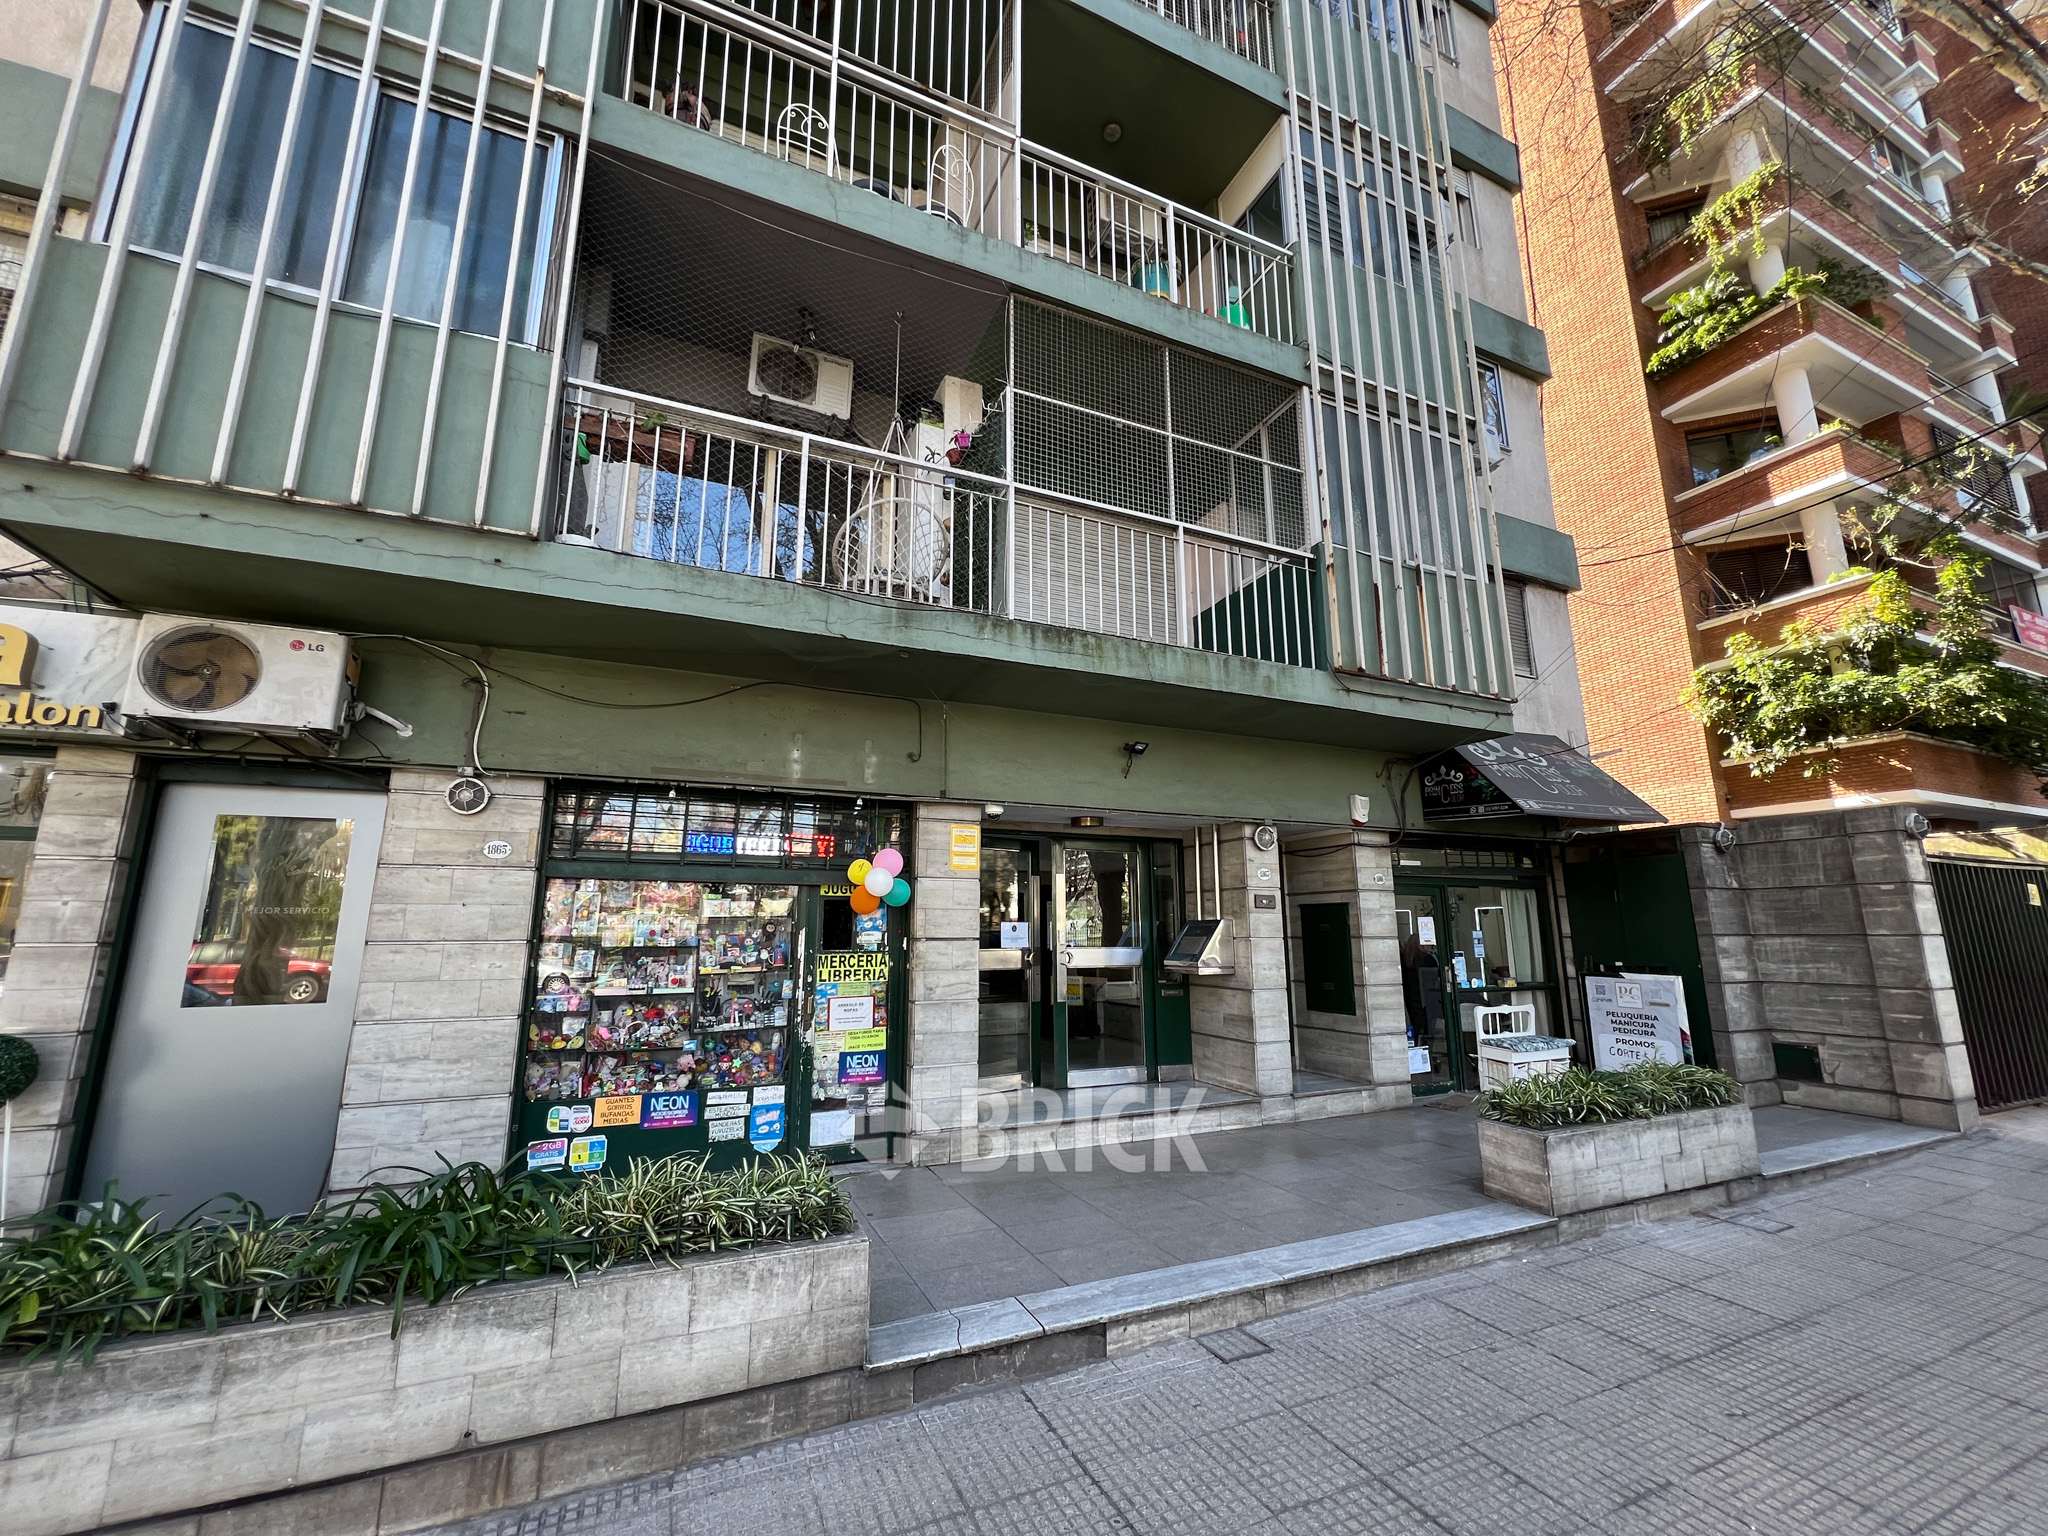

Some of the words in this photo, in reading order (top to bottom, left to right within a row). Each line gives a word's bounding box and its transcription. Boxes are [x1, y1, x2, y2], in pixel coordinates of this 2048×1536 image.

[308, 643, 325, 652] LG
[487, 844, 508, 855] 1865
[283, 906, 330, 915] SERVICIO
[818, 955, 888, 969] MERCERIA
[818, 969, 887, 982] LIBRERIA
[1606, 1010, 1660, 1022] PELUQUERIA
[1610, 1018, 1657, 1029] MANICURA
[1612, 1026, 1657, 1037] PEDICURA
[1615, 1038, 1656, 1049] PROMOS
[1609, 1046, 1641, 1060] CORTE
[846, 1054, 879, 1068] NEON
[605, 1097, 635, 1105] GUANTES
[650, 1095, 689, 1111] NEON
[600, 1110, 634, 1118] BUFANDAS
[602, 1117, 629, 1125] MEDIAS
